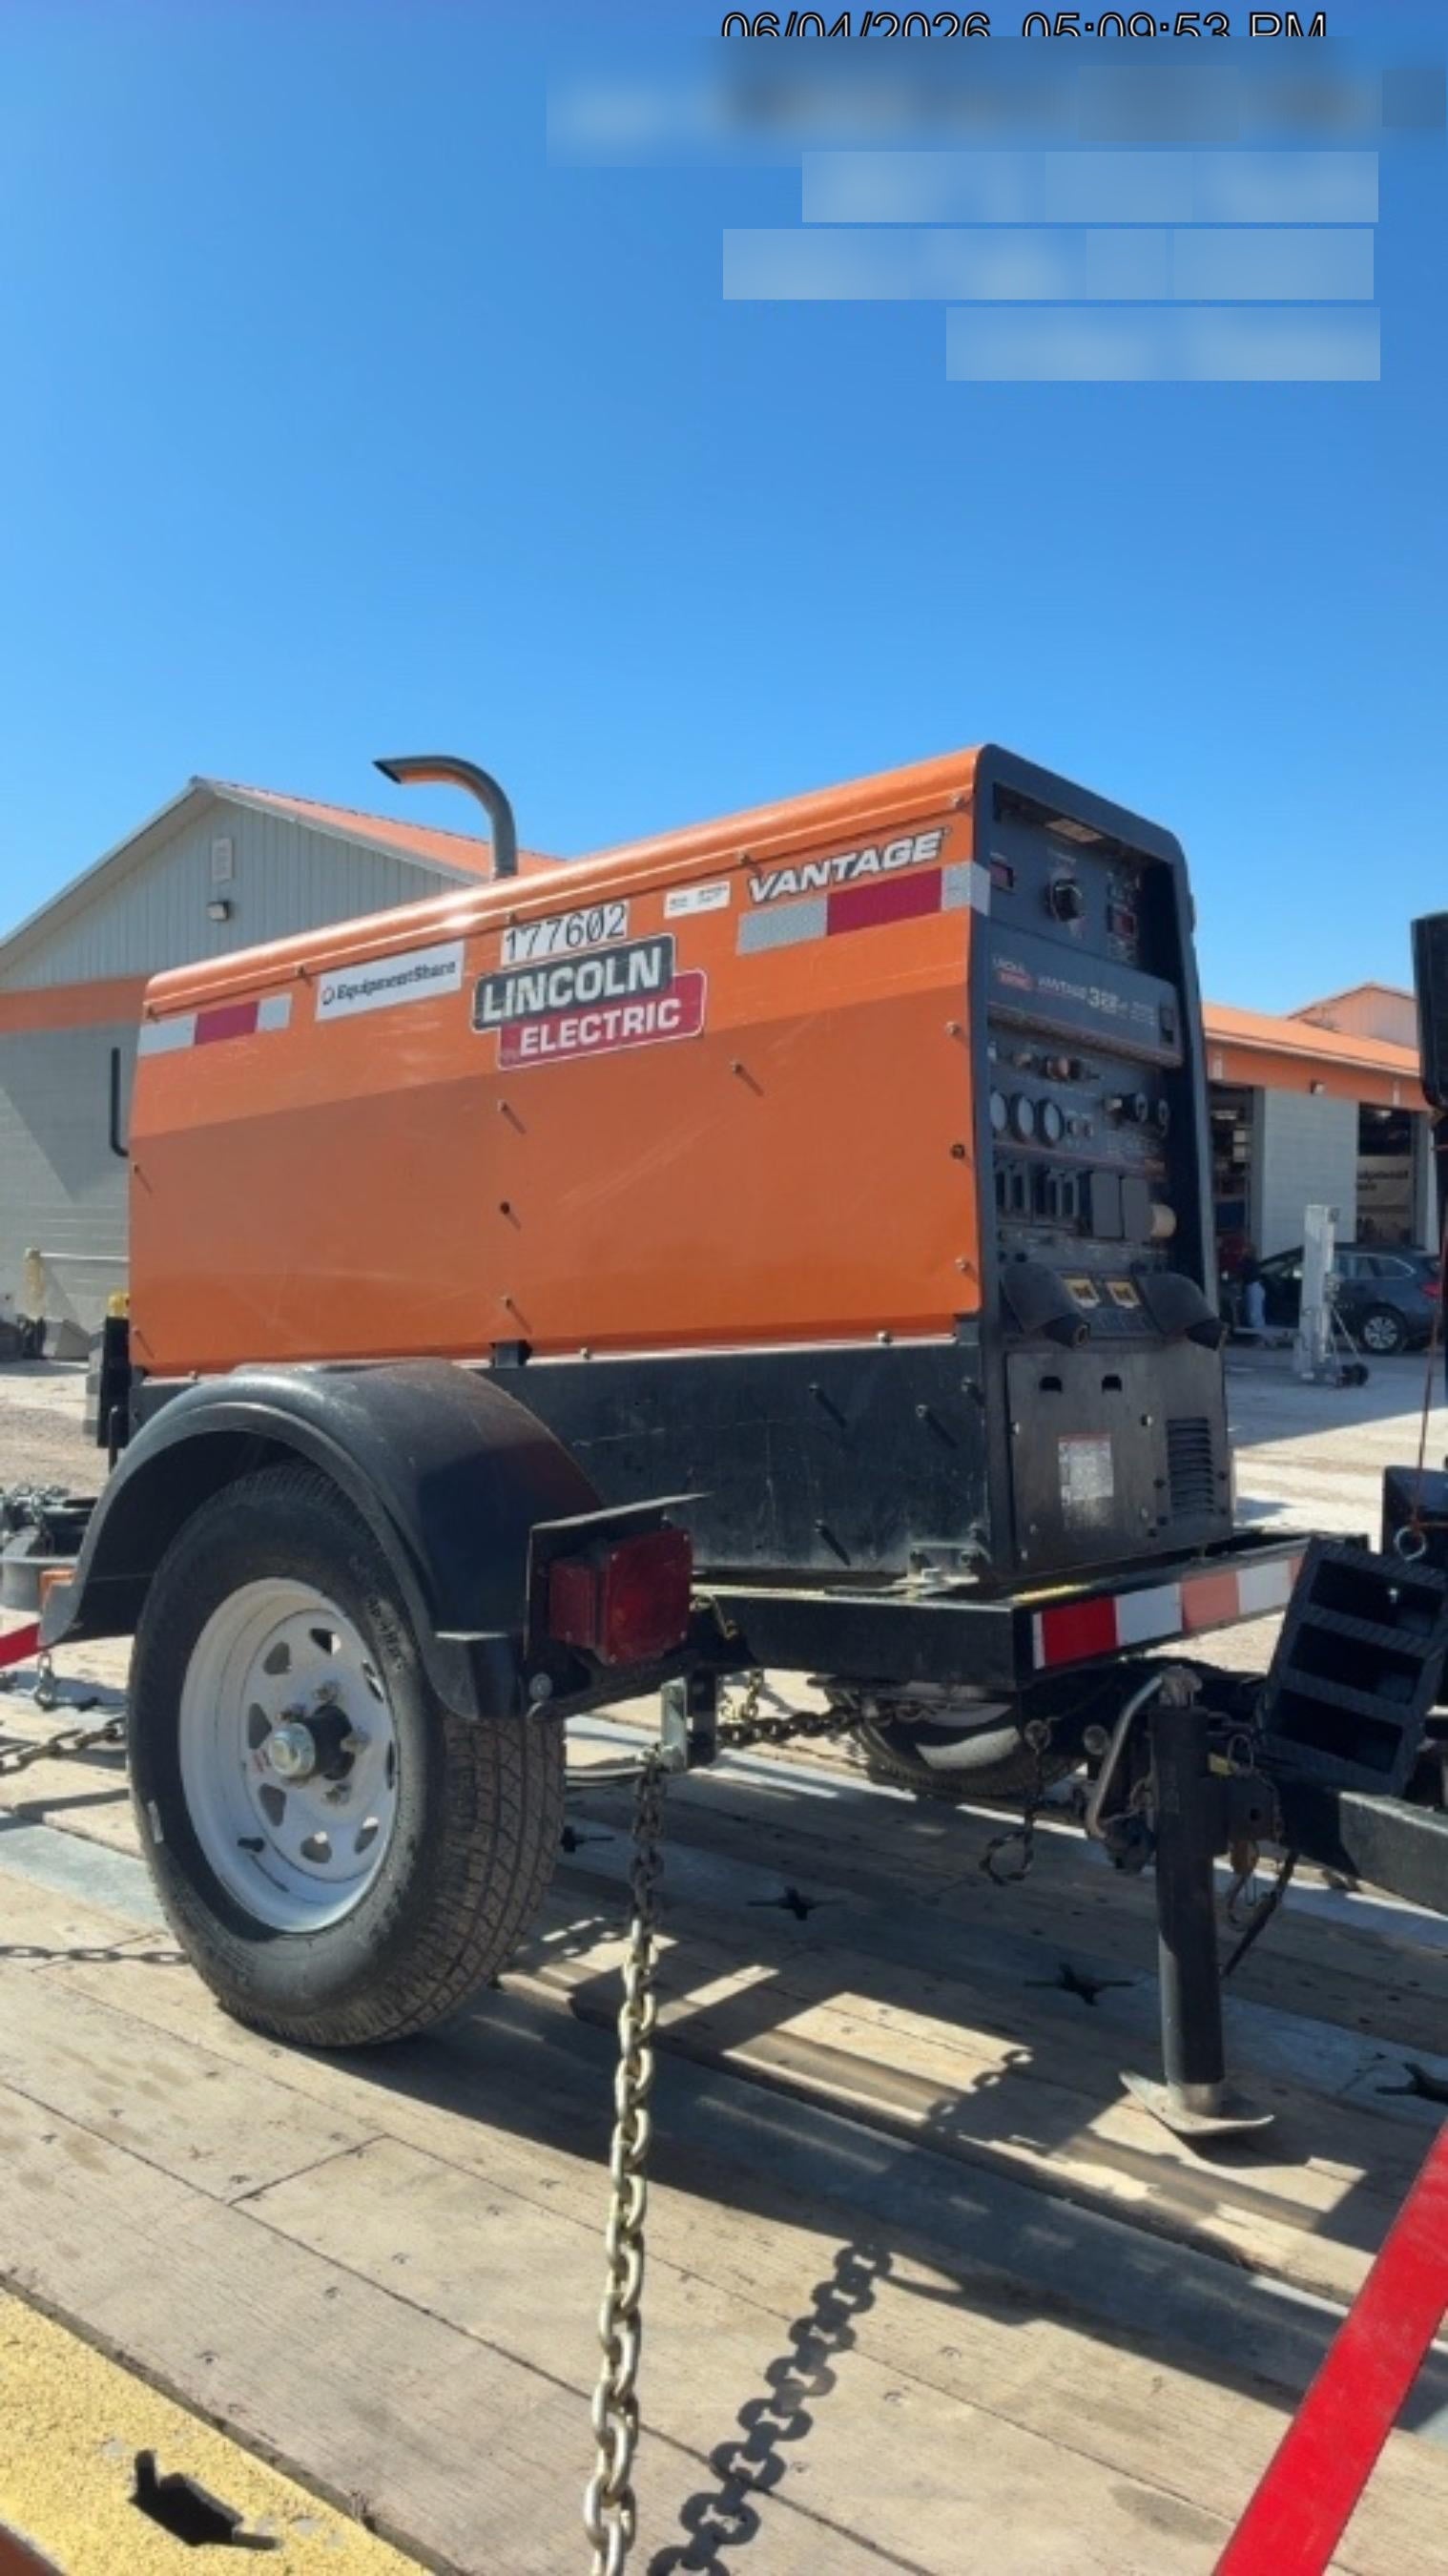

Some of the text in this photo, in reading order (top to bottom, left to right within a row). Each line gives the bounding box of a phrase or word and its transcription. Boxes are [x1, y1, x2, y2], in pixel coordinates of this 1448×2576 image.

[748, 828, 945, 904] VANTAGE
[506, 903, 627, 963] 177602
[482, 945, 663, 1023] LINCOLN
[520, 998, 681, 1057] ELECTRIC
